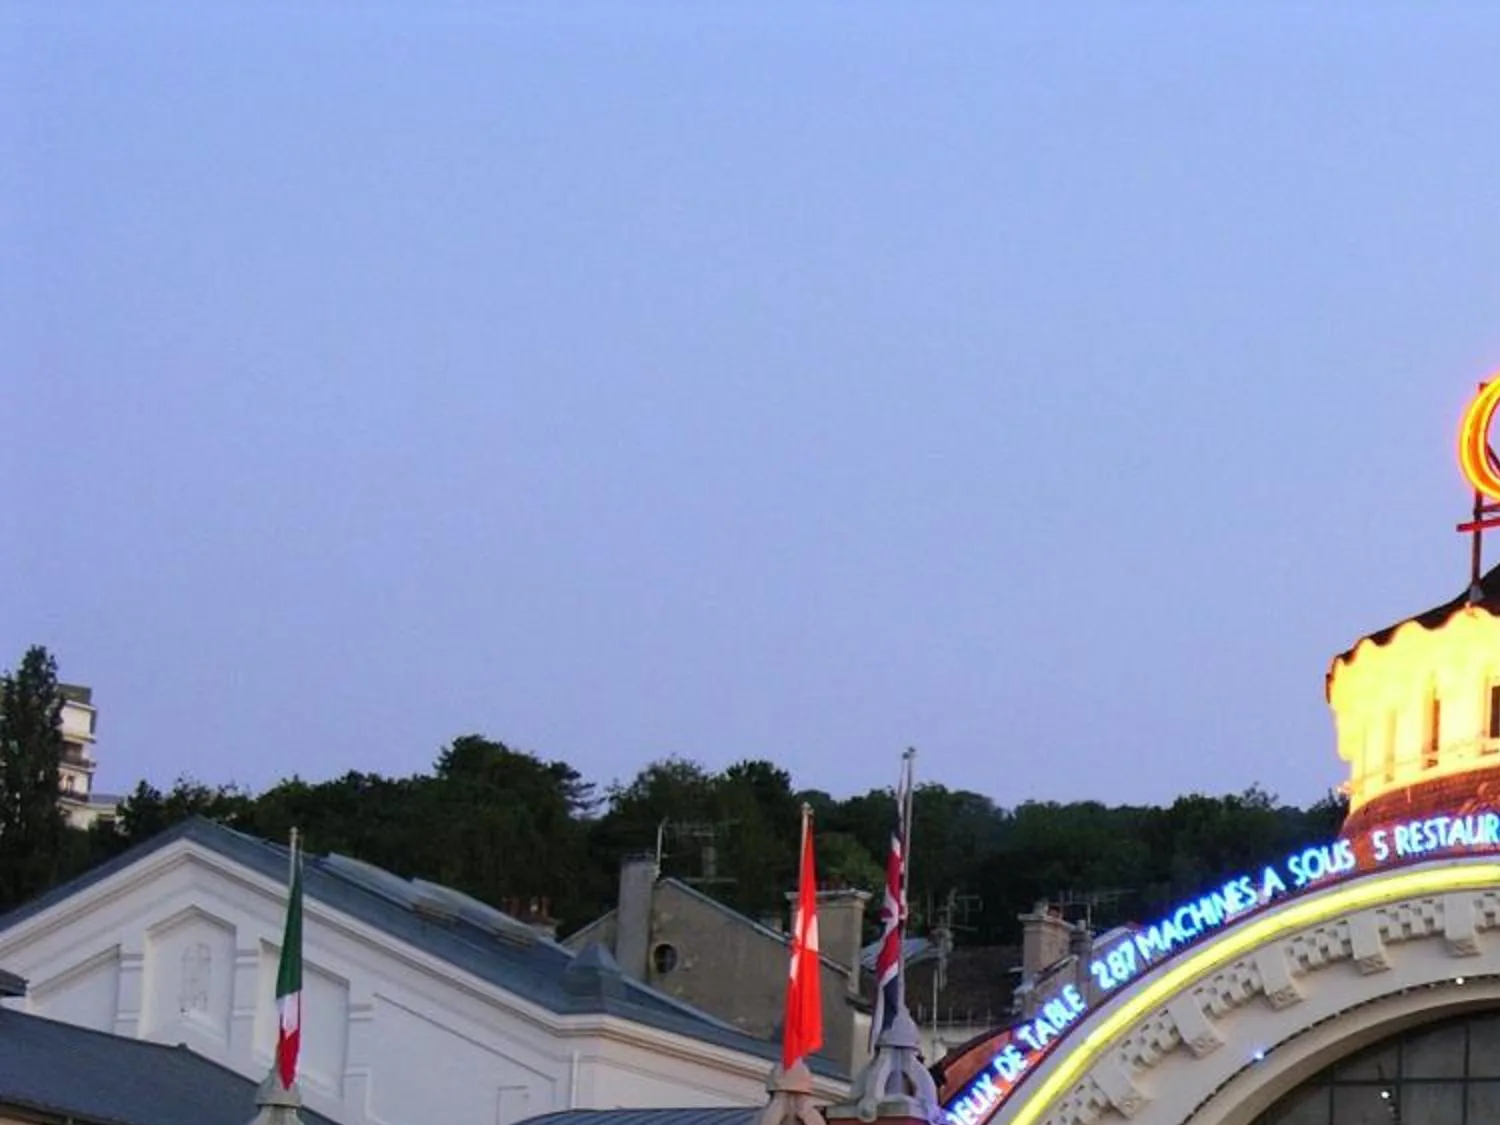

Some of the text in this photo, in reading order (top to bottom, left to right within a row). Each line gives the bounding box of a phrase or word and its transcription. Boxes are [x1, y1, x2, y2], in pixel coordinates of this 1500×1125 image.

[993, 1045, 1028, 1082] DE
[1017, 984, 1086, 1050] TABLE
[1090, 935, 1137, 989] 287
[1135, 875, 1257, 961] MACHINES
[1262, 865, 1286, 899] A
[1287, 840, 1356, 886] SOUS
[1372, 830, 1391, 861] 5
